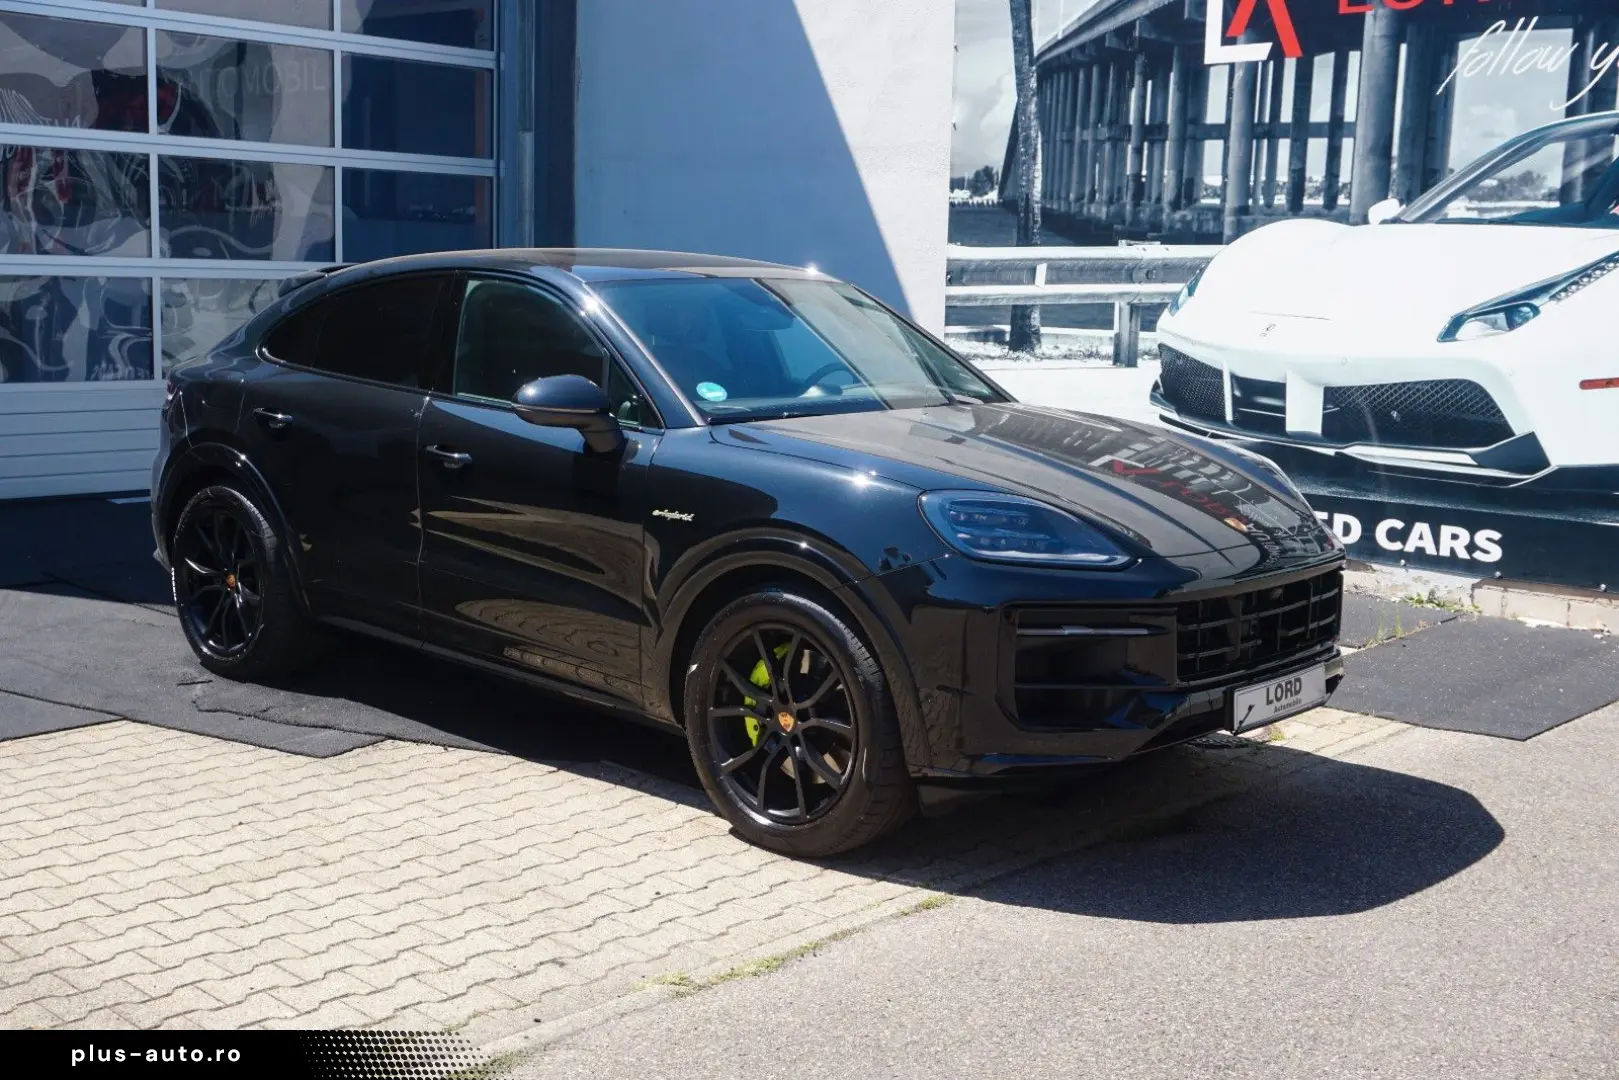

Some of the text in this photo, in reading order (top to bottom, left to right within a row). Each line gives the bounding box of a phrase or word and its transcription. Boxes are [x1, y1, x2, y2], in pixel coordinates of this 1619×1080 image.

[1436, 16, 1579, 95] follow
[1374, 518, 1503, 563] CARS
[1266, 677, 1302, 705] LORD
